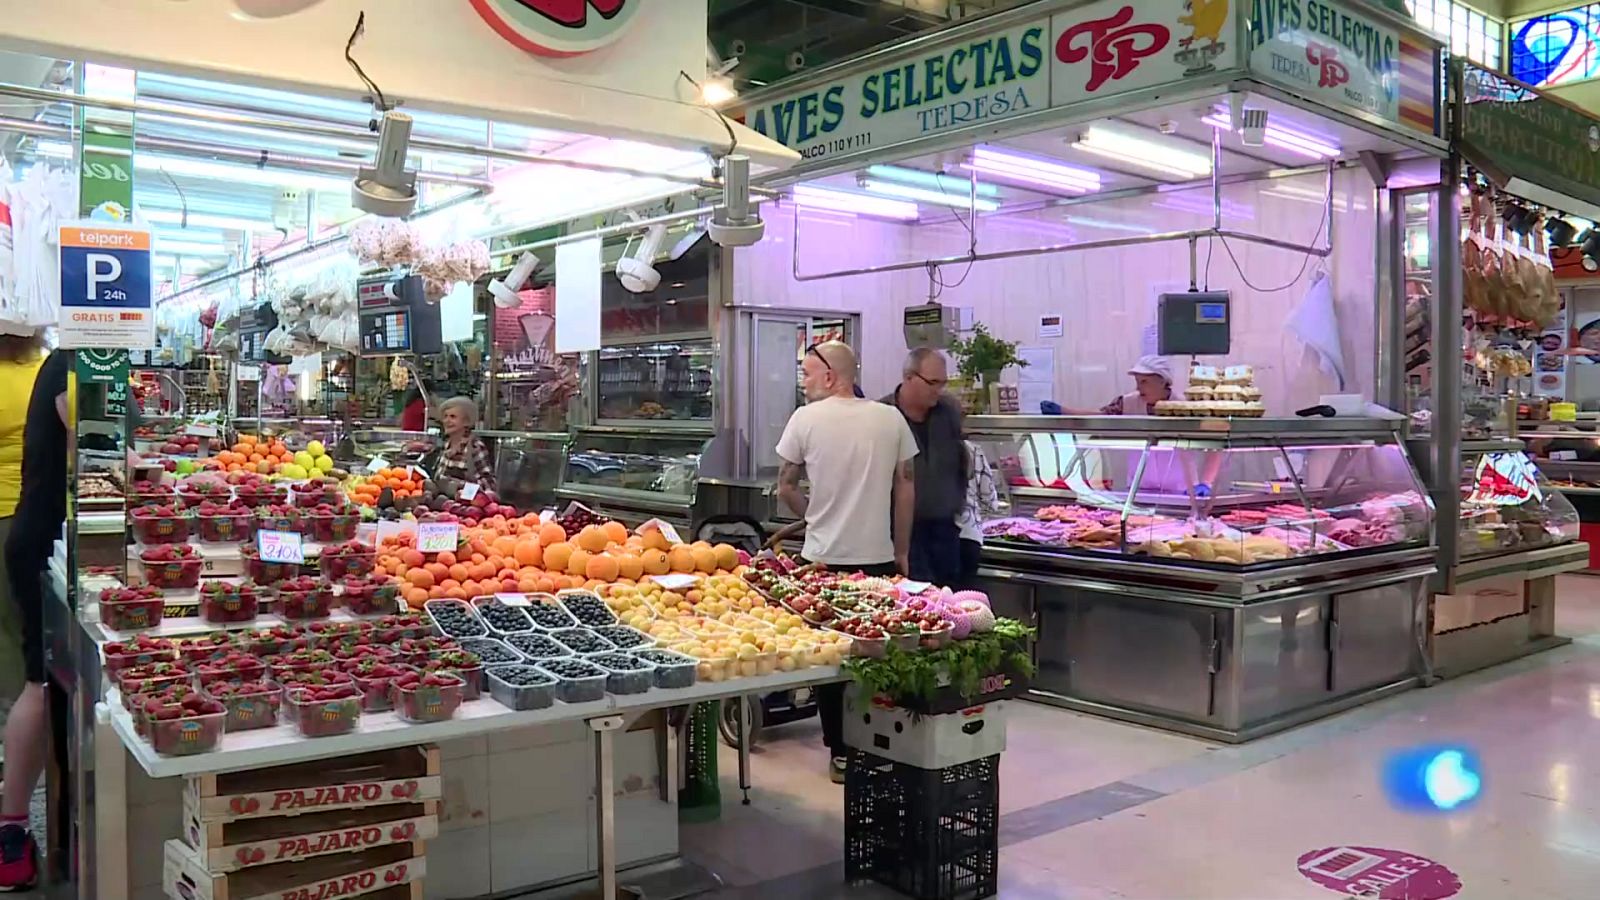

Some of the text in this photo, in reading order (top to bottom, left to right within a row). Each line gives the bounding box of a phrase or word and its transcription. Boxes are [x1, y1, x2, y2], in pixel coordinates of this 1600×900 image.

[1250, 0, 1394, 76] AVES SELECTAS
[752, 28, 1043, 147] AVES SELECTAS
[917, 86, 1033, 133] TERESA
[829, 139, 845, 153] 110
[847, 136, 853, 149] Y
[855, 132, 871, 147] 111
[80, 231, 134, 247] telpark
[86, 253, 122, 300] P
[104, 289, 127, 300] 24h
[72, 312, 115, 322] GRATIS
[90, 362, 111, 371] GOOD
[270, 783, 383, 811] PAJARO
[275, 827, 382, 860] PAJARO
[1401, 856, 1431, 867] 3
